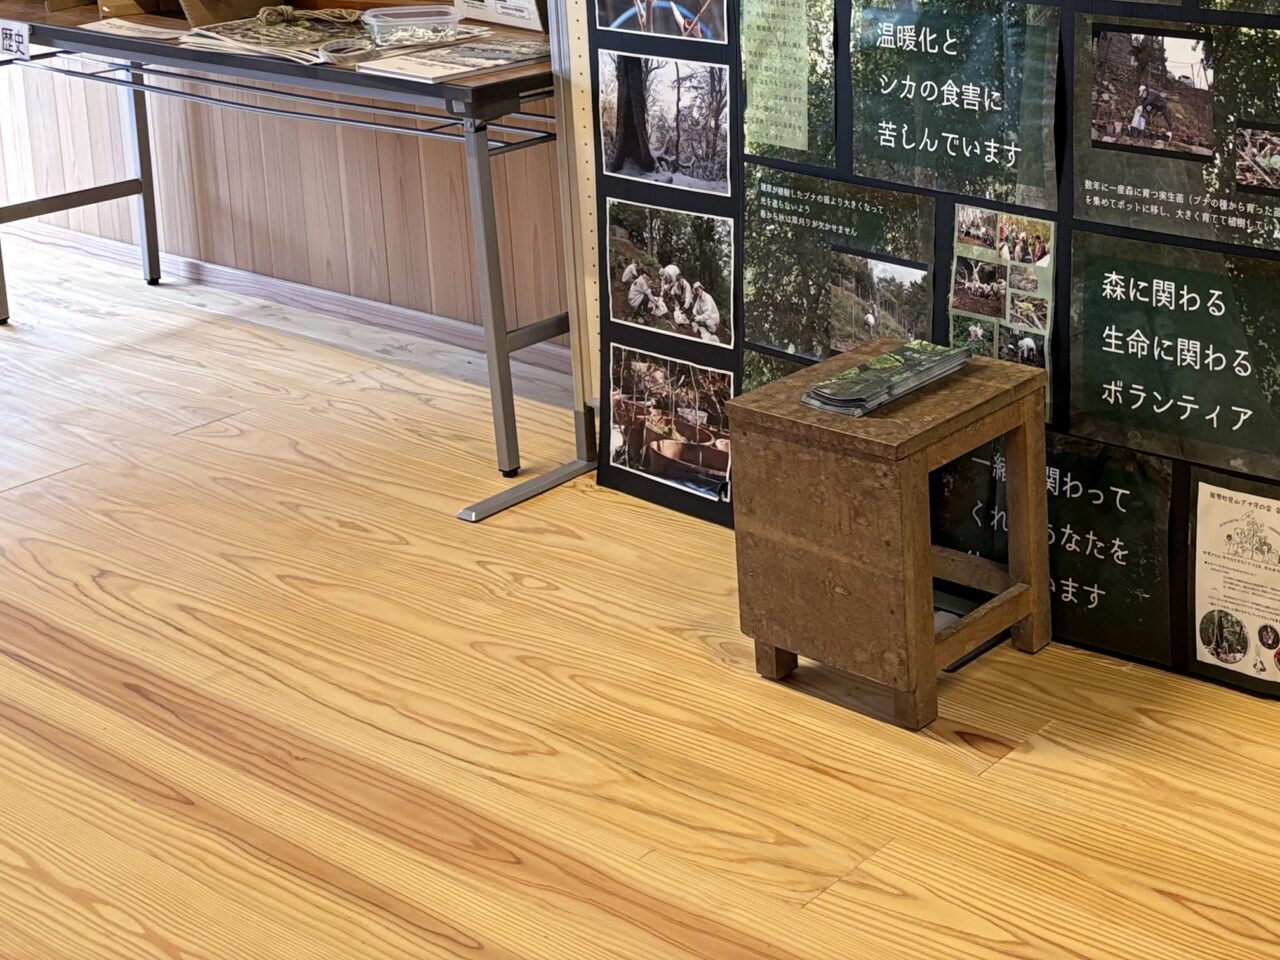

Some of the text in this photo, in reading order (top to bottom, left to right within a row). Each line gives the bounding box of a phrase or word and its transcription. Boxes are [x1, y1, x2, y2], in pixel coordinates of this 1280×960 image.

[876, 21, 959, 56] 温暖化と
[879, 74, 1003, 112] シカの食害に
[878, 120, 1022, 168] 苦しんでいます
[1102, 270, 1226, 317] 森に関わる
[1101, 324, 1252, 376] 生命に関わる
[1102, 380, 1253, 431] ボランティア
